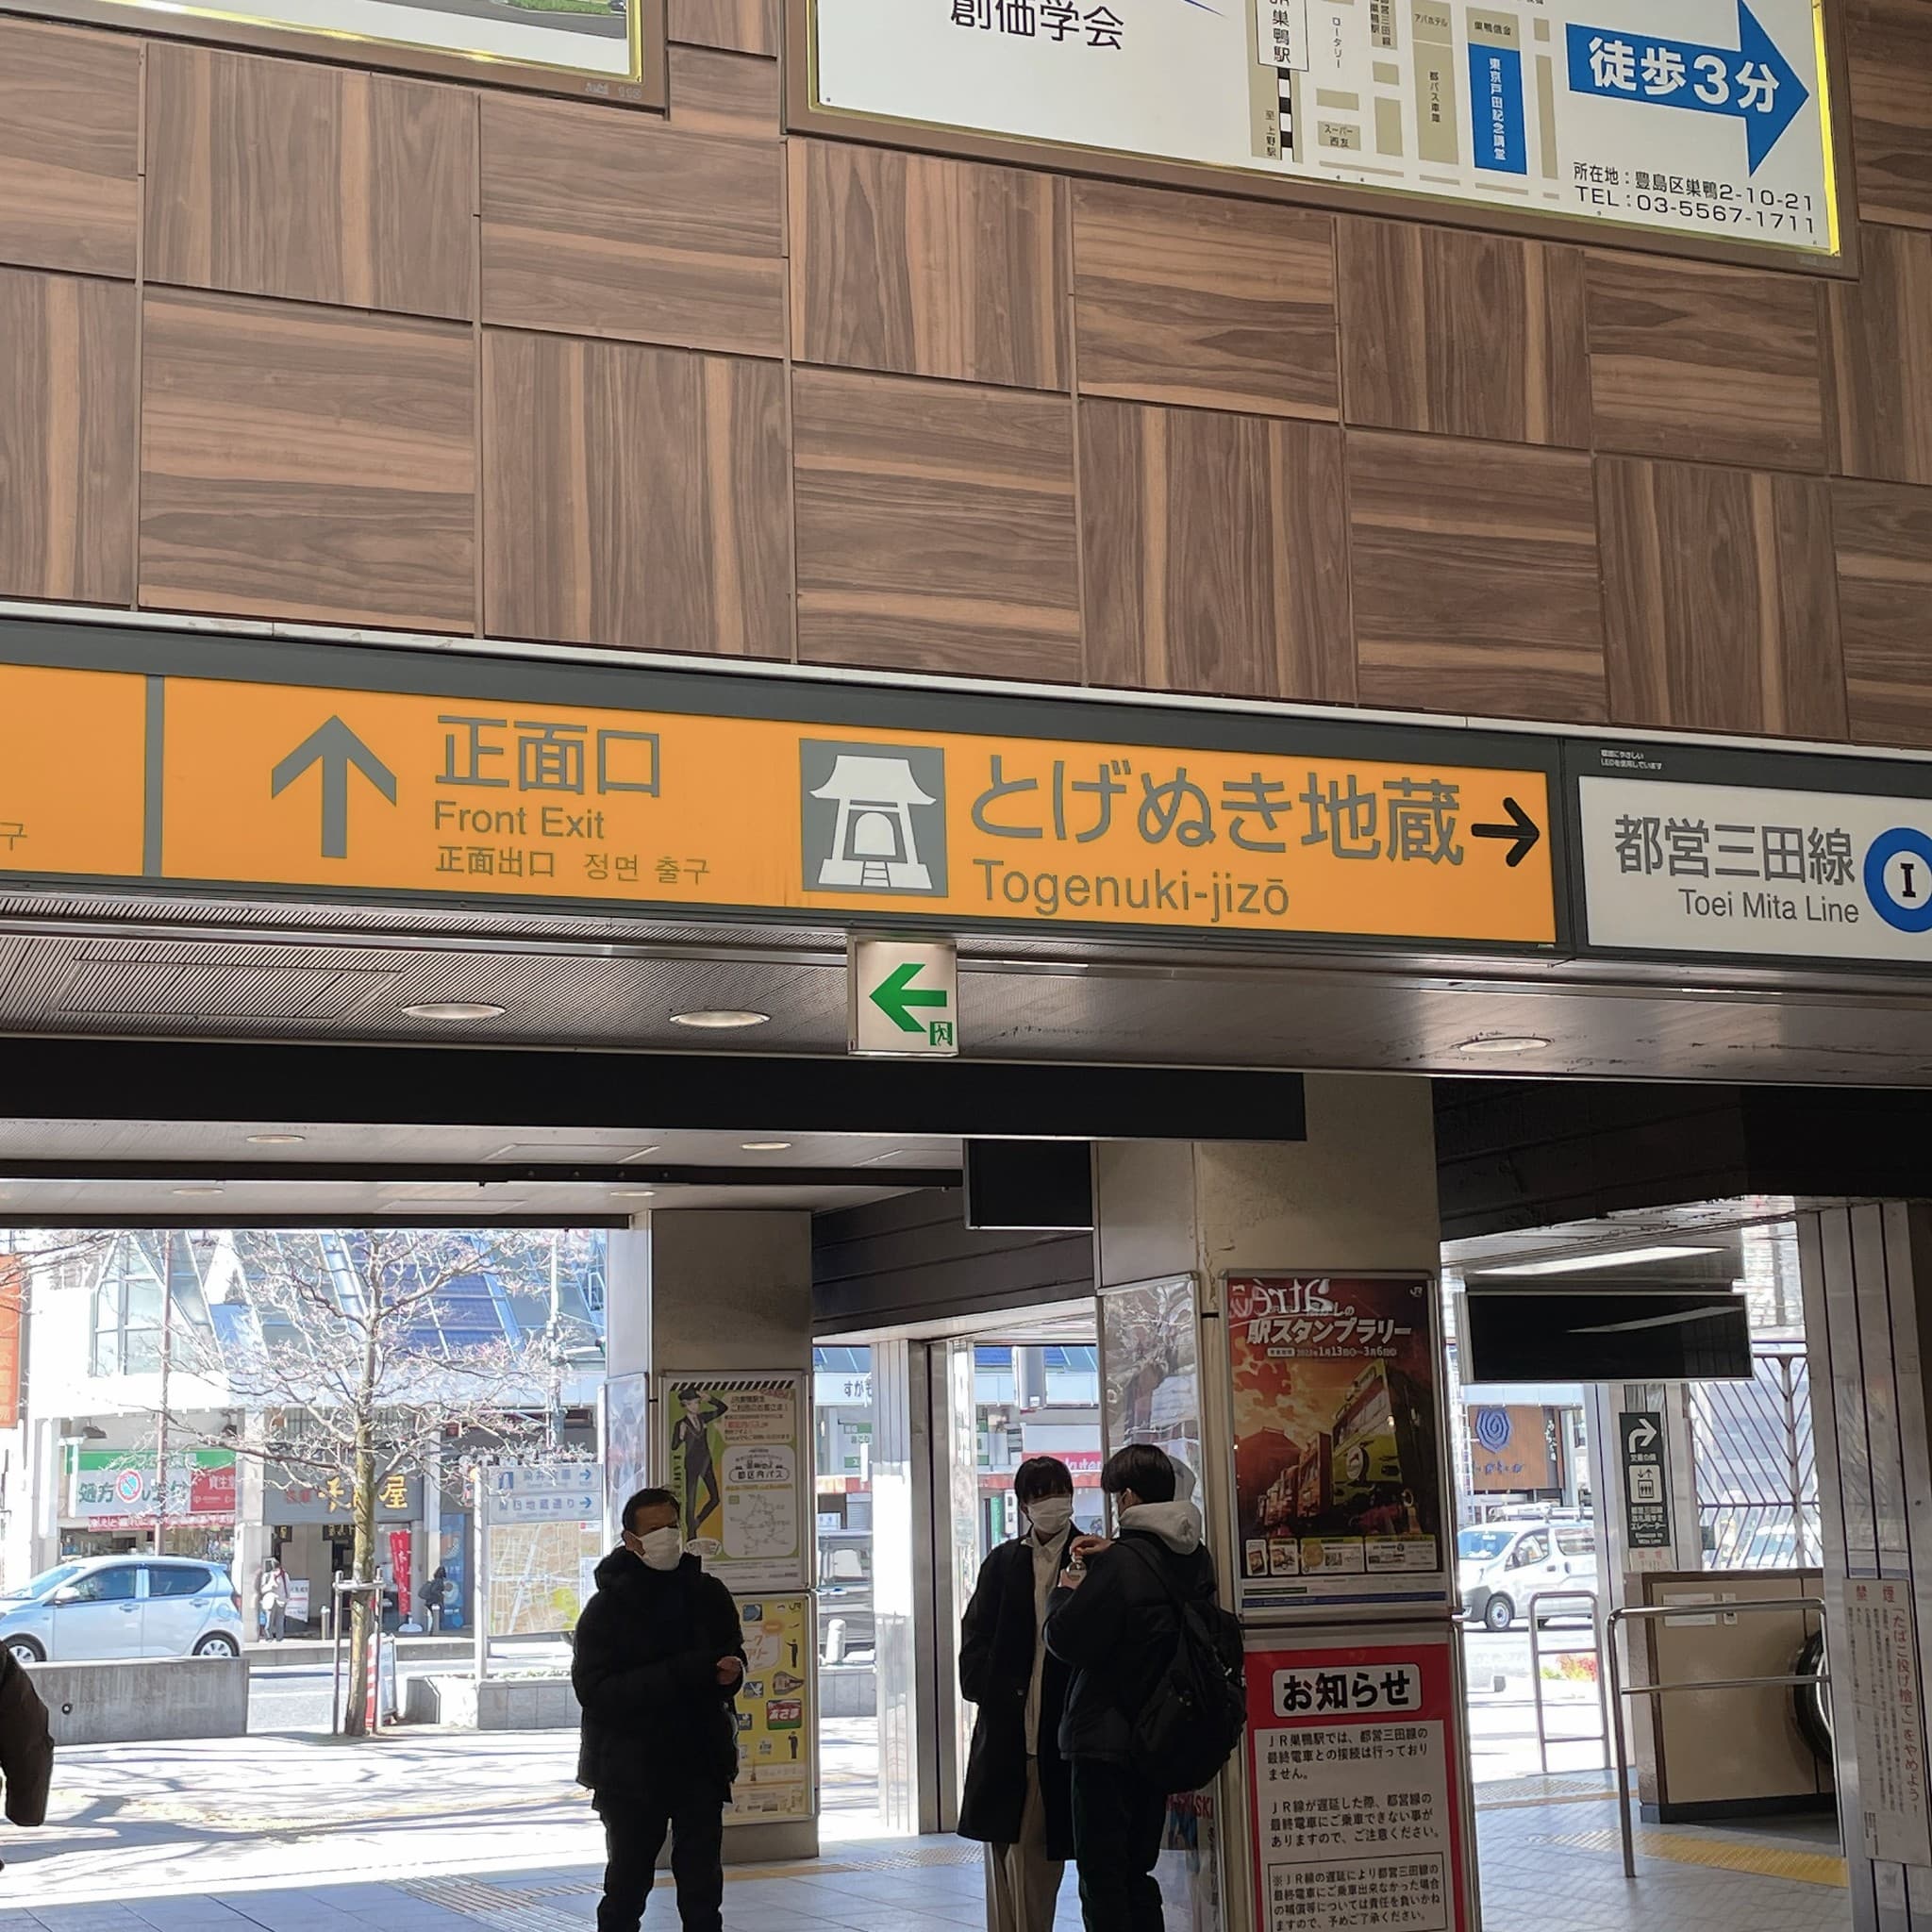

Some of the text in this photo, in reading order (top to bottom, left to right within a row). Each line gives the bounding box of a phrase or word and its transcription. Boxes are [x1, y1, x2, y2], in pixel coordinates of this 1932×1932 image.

[949, 0, 1125, 50] 創価学会
[1589, 36, 1780, 113] 徒歩3分
[1324, 124, 1354, 135] スーパー
[435, 714, 660, 798] 正面口
[434, 801, 606, 840] Front Exit
[971, 755, 1465, 866] とげぬき地蔵
[435, 845, 555, 878] 正面出口
[583, 852, 710, 887] 정면 출구
[1614, 814, 1857, 887] 都営三田線
[973, 858, 1291, 923] Togenuki-jizō
[1900, 862, 1917, 899] I
[1678, 888, 1859, 924] Toei Mita Line
[1245, 1316, 1412, 1344] 駅スタンプラリー
[1283, 1670, 1410, 1711] お知らせ
[1269, 1768, 1308, 1781] ません。
